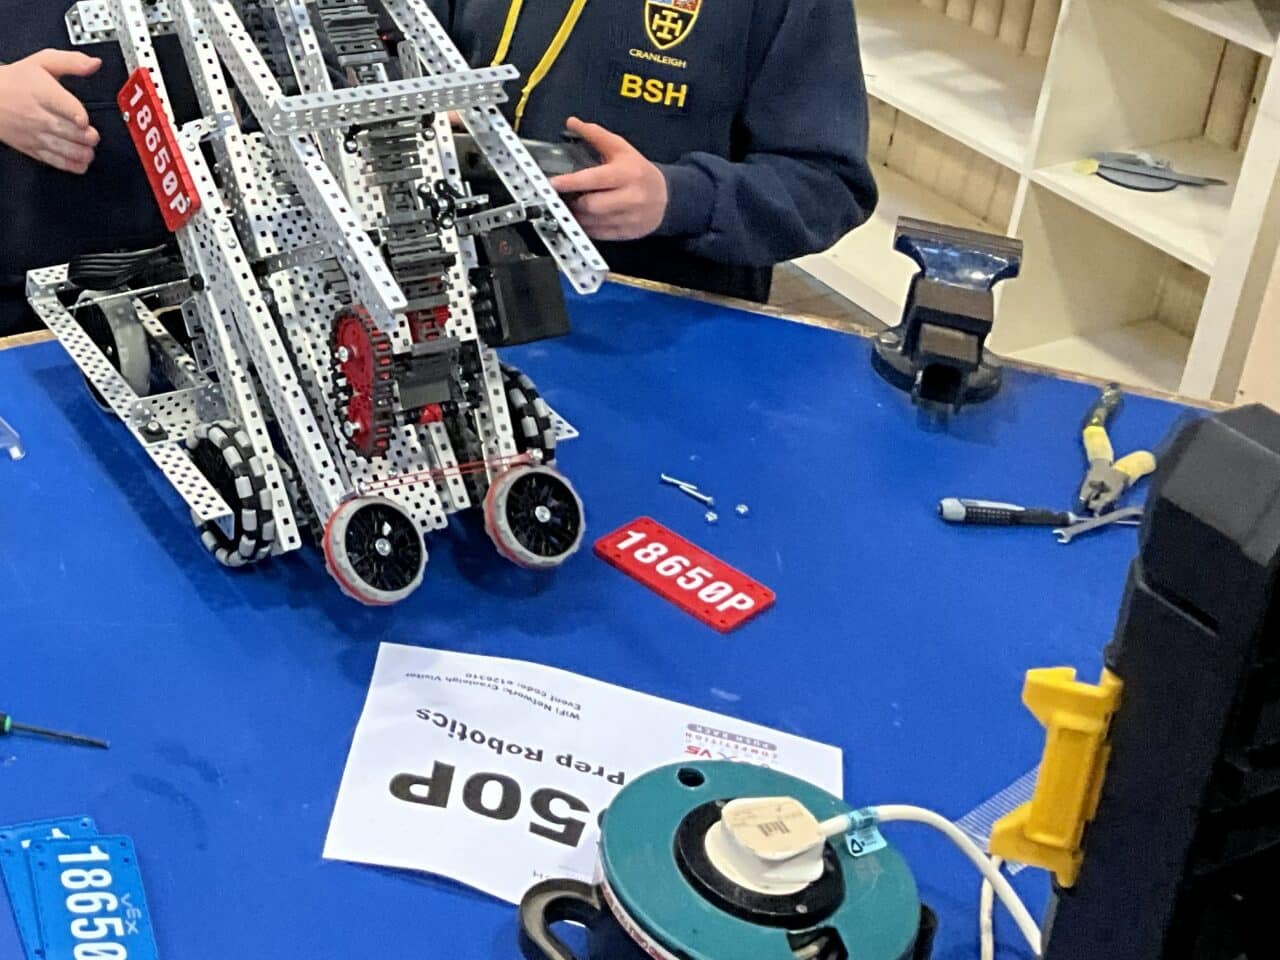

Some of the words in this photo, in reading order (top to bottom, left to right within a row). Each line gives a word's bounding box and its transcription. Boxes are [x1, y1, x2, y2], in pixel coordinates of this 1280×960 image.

[628, 48, 687, 69] CRANLEIGH
[620, 73, 688, 107] BSH
[129, 83, 188, 215] 18650P
[617, 530, 755, 612] 18650P
[415, 708, 544, 762] Robotics
[555, 753, 625, 786] Prep
[389, 760, 593, 848] 50P
[120, 893, 142, 935] VEX
